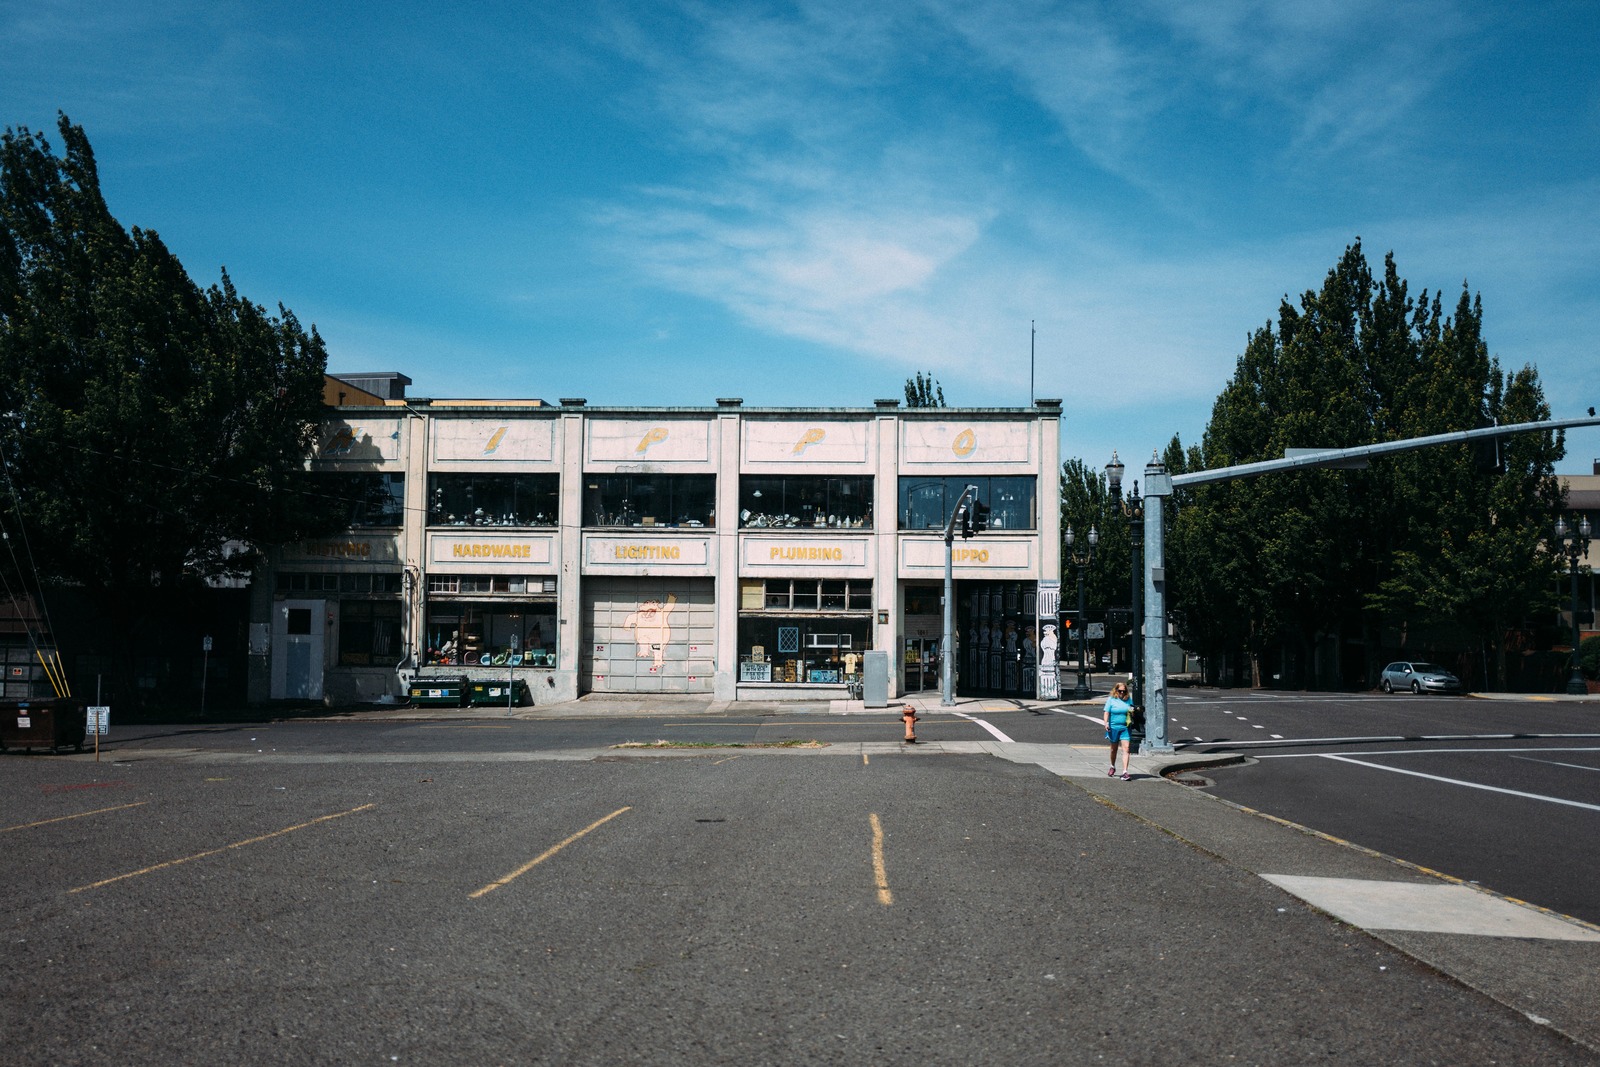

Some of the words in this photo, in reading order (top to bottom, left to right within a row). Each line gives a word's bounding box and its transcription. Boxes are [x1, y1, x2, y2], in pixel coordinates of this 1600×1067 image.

[635, 427, 669, 455] P
[791, 428, 826, 456] P
[306, 542, 371, 556] HISTORIC
[453, 544, 531, 558] HARDWARE
[615, 545, 680, 559] LIGHTING
[770, 547, 843, 560] PLUMBING
